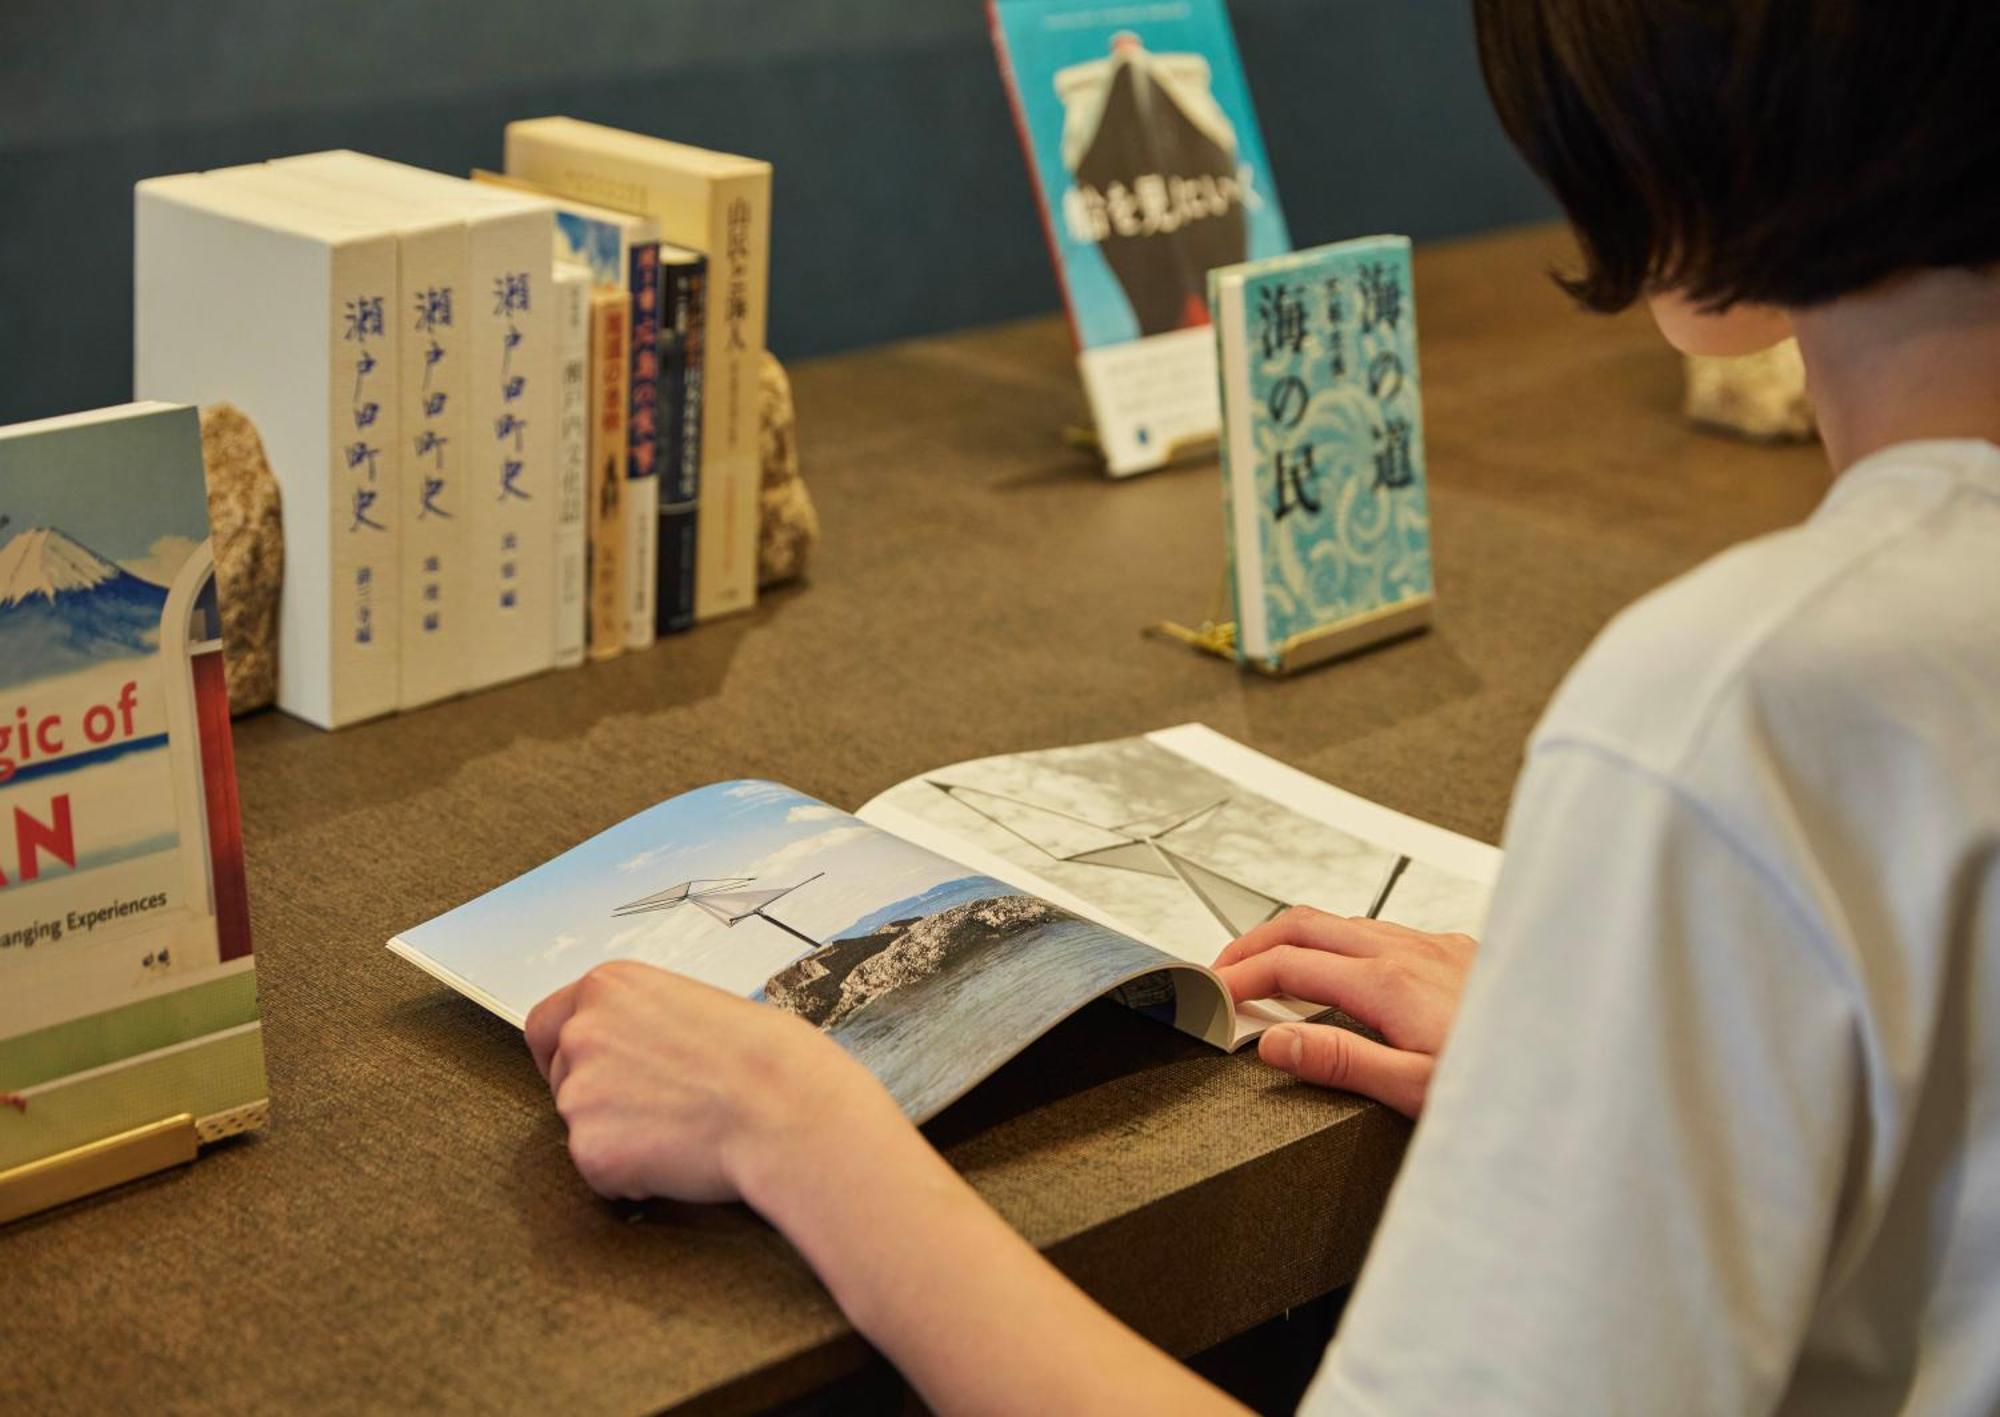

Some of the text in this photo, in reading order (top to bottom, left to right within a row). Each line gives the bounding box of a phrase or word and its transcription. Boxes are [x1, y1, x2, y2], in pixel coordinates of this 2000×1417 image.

[1259, 283, 1322, 522] 海の民
[1357, 262, 1415, 490] 海の道
[83, 681, 137, 744] of
[0, 793, 77, 888] N
[66, 892, 167, 932] Experiences
